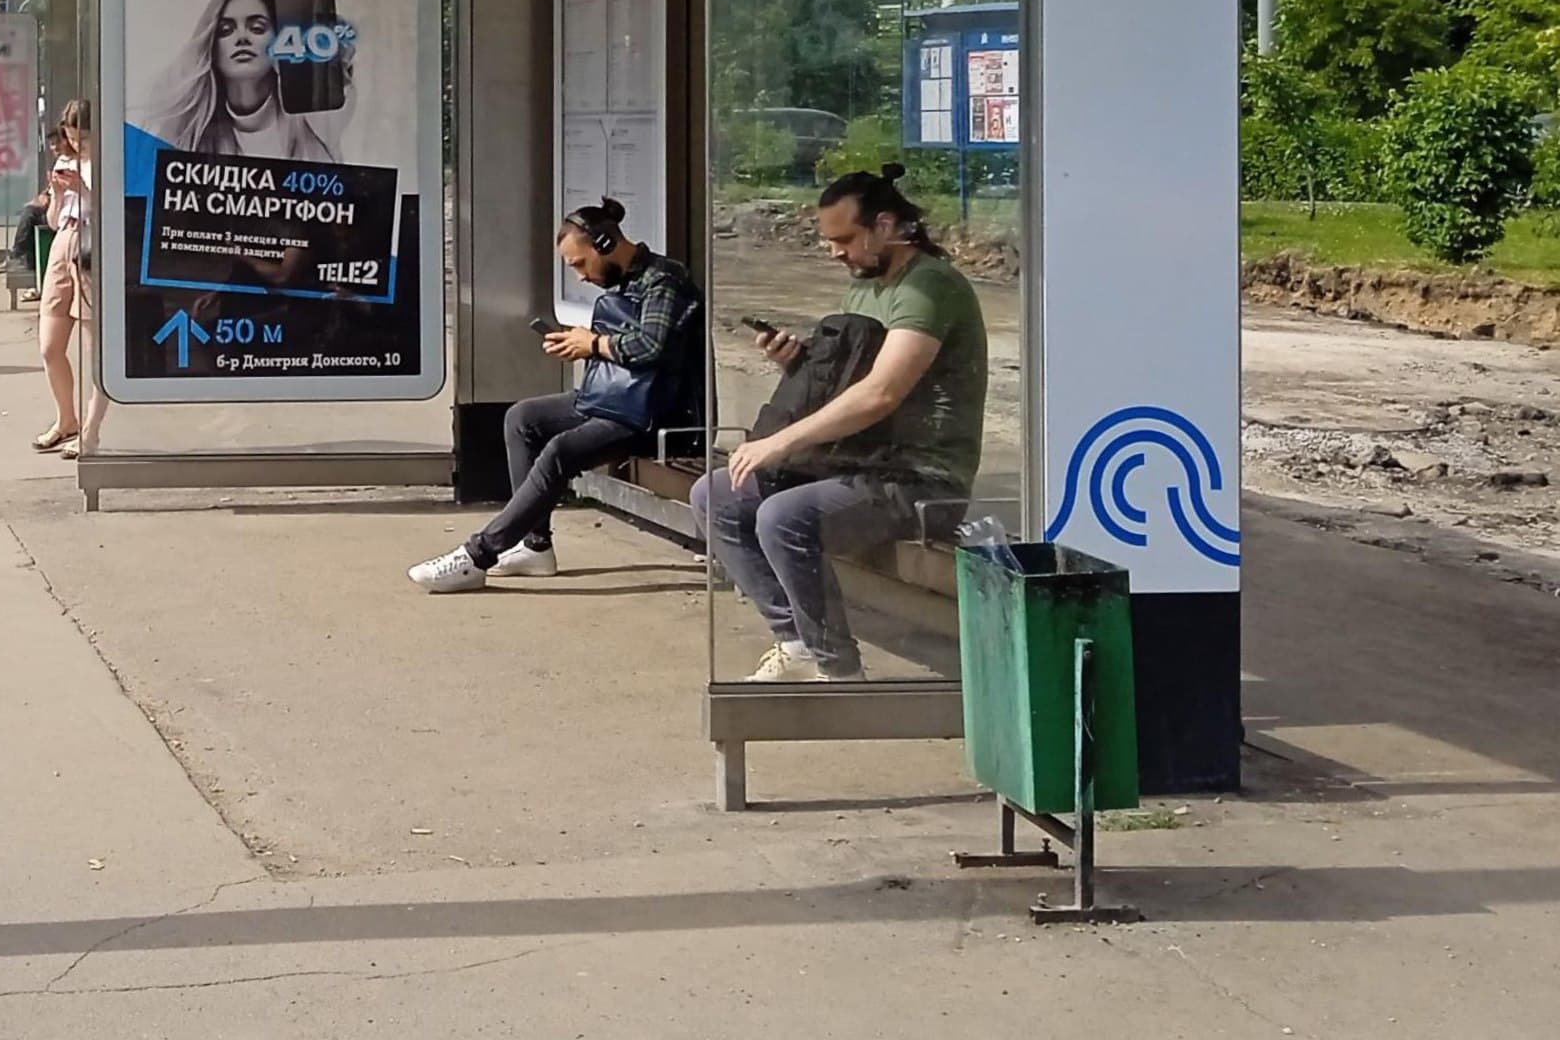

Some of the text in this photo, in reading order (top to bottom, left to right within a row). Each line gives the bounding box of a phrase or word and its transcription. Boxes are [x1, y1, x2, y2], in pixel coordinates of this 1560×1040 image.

[166, 161, 345, 196] СКИДКА 40%
[163, 189, 355, 225] НА СМАРТФОН
[161, 226, 310, 248] При оплате 3 месяцев связи
[160, 241, 286, 259] и комплексной защиты
[317, 260, 379, 285] TELE2
[215, 318, 255, 344] 50
[216, 353, 401, 371] б-р Дмитрия Донского, 10
